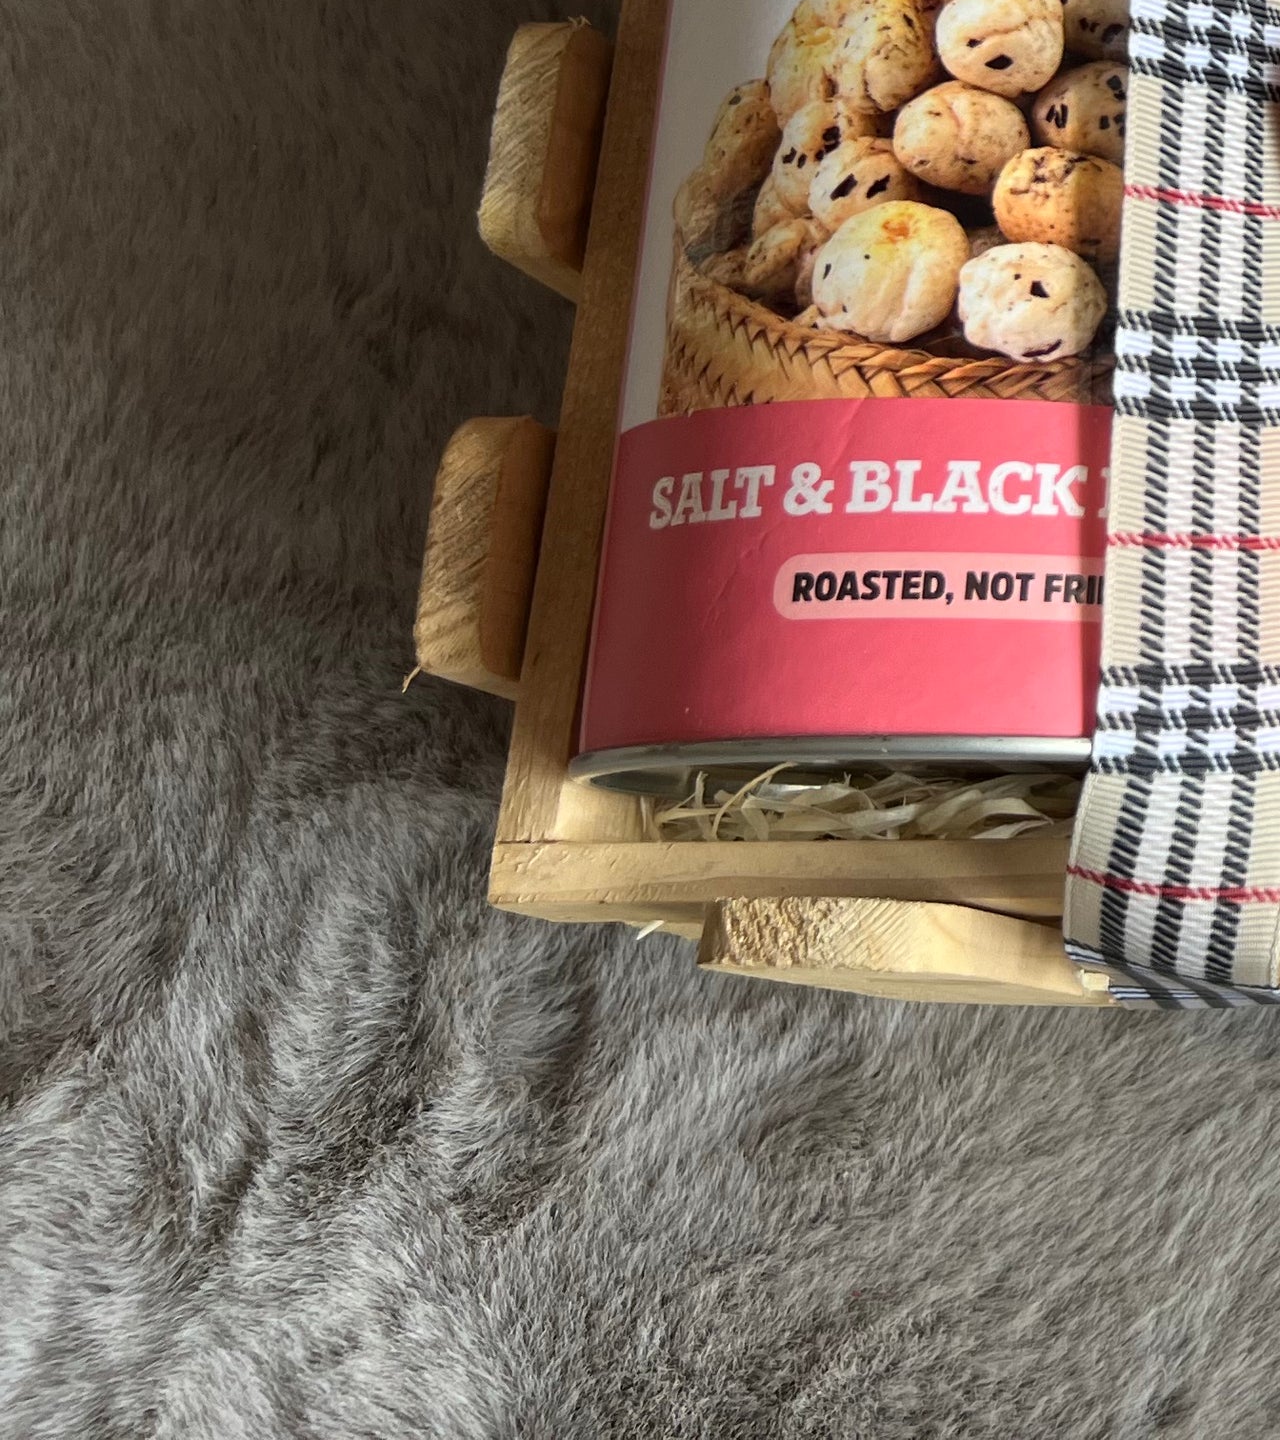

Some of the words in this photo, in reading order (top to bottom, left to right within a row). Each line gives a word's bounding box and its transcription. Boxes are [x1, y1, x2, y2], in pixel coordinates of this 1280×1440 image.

[649, 462, 775, 530] SALT
[783, 460, 834, 516] &
[845, 459, 1089, 518] BLACK
[792, 569, 954, 606] ROASTED,
[964, 571, 1032, 605] NOT
